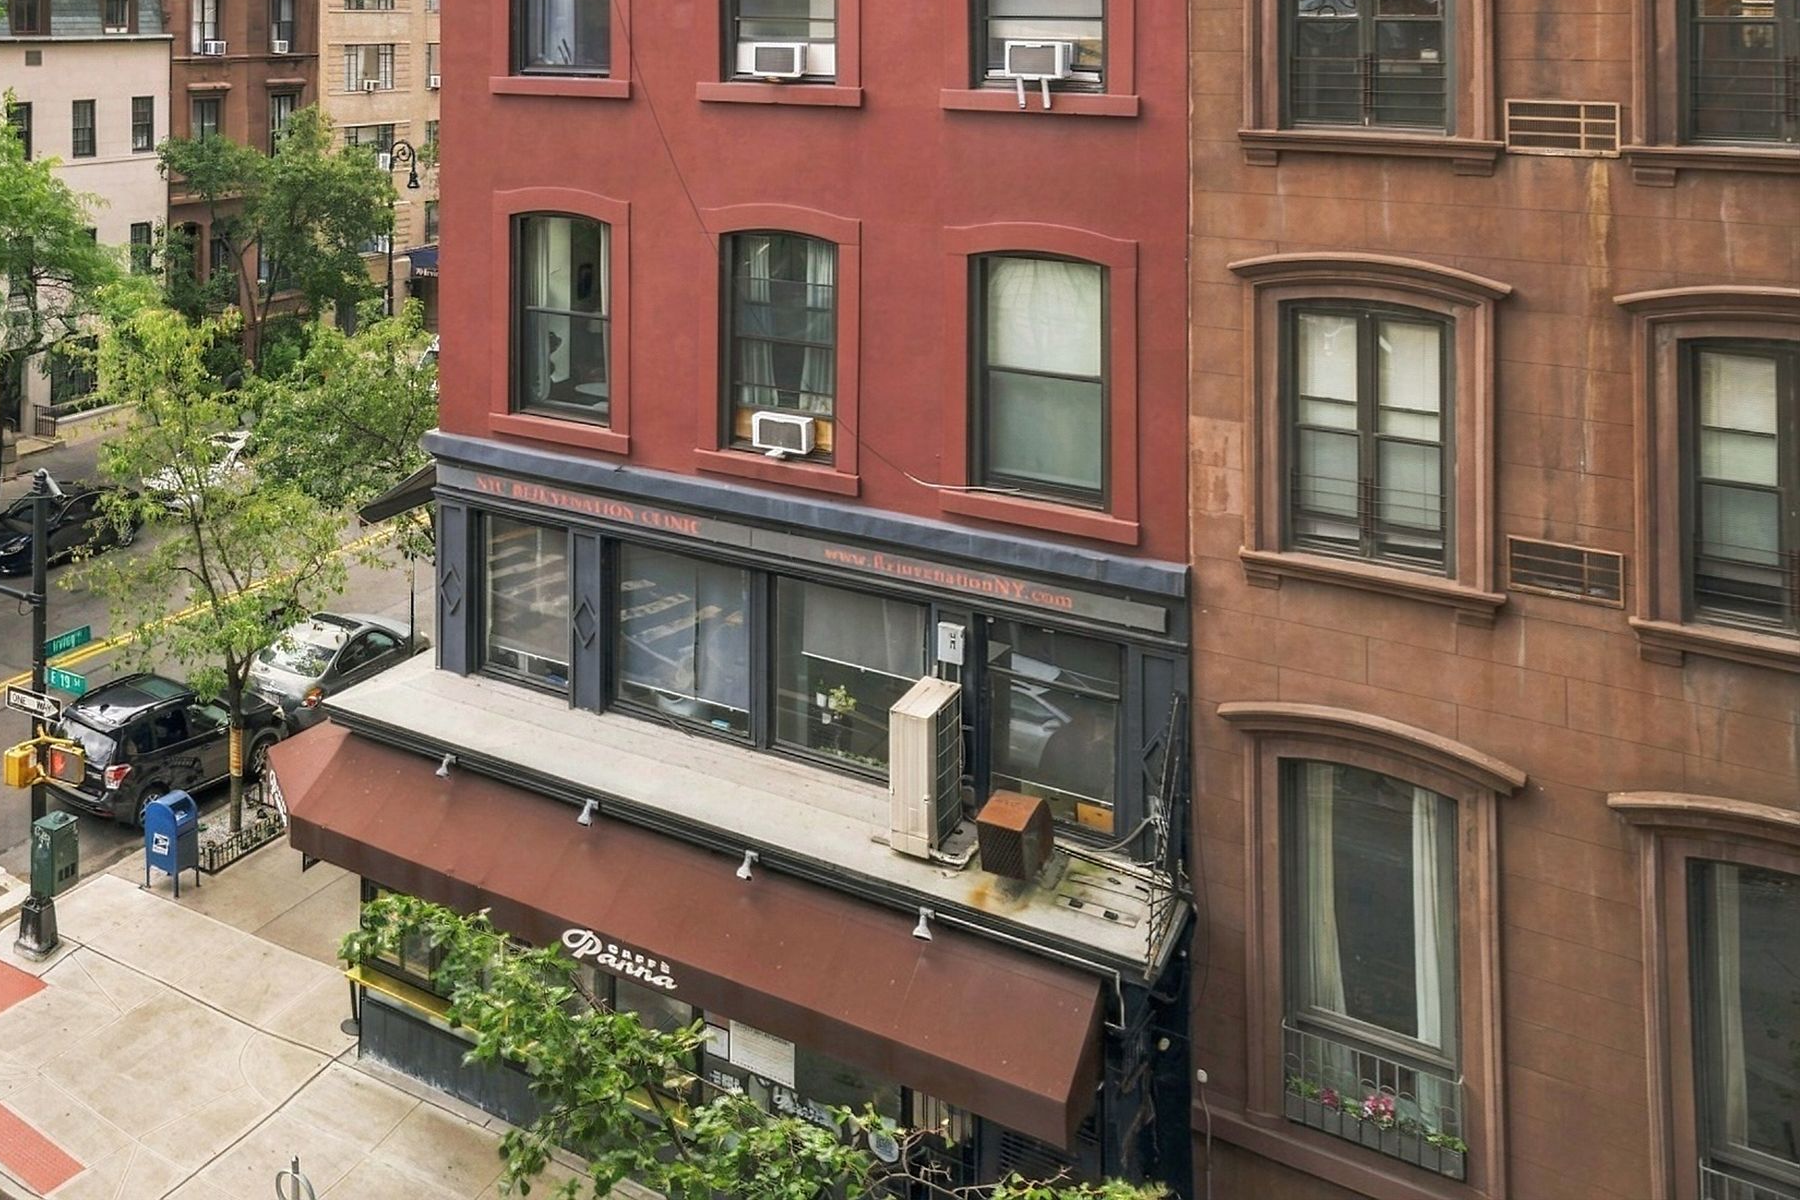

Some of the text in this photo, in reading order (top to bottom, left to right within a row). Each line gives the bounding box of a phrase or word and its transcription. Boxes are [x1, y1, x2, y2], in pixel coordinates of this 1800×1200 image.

[476, 473, 702, 534] NYC REJUVENATION CLINIC
[824, 547, 1073, 609] www.RejuvenationNY.com
[53, 634, 76, 652] Irving
[51, 671, 57, 684] E
[60, 674, 71, 689] 19
[12, 693, 52, 712] ONE WAY
[561, 928, 679, 990] Panna
